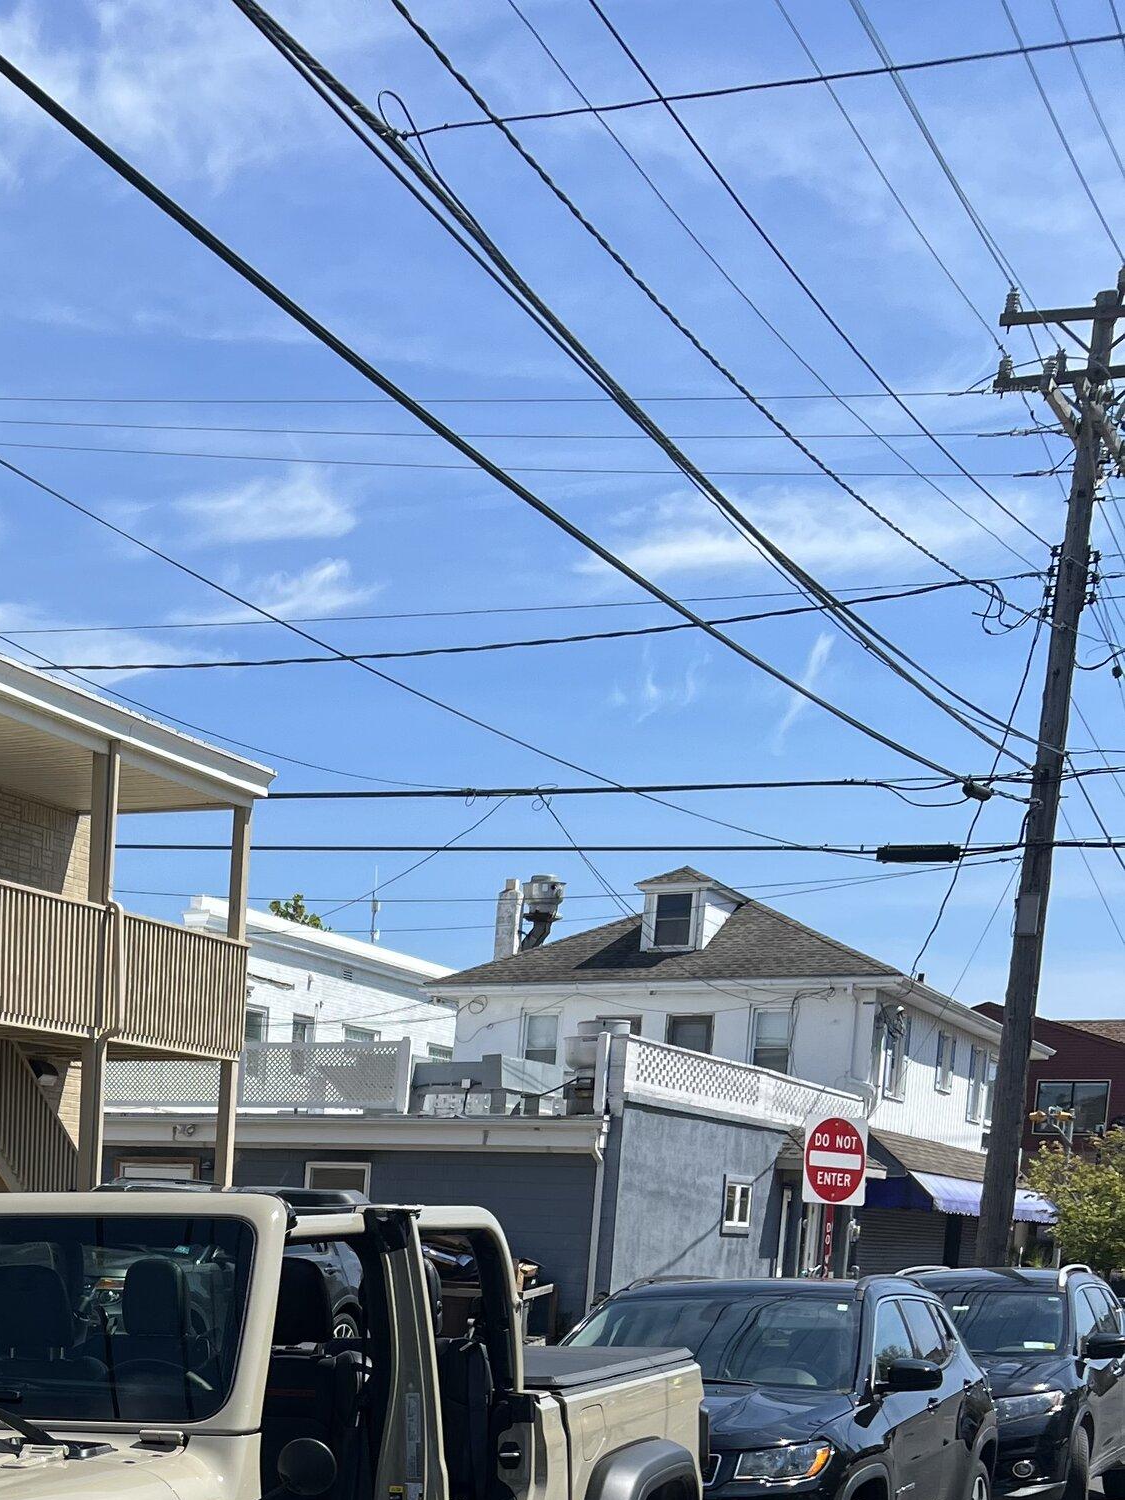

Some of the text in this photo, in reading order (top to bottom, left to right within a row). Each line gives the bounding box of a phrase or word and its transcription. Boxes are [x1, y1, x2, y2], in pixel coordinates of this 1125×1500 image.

[814, 1132, 857, 1150] DO NOT
[816, 1171, 851, 1187] ENTER
